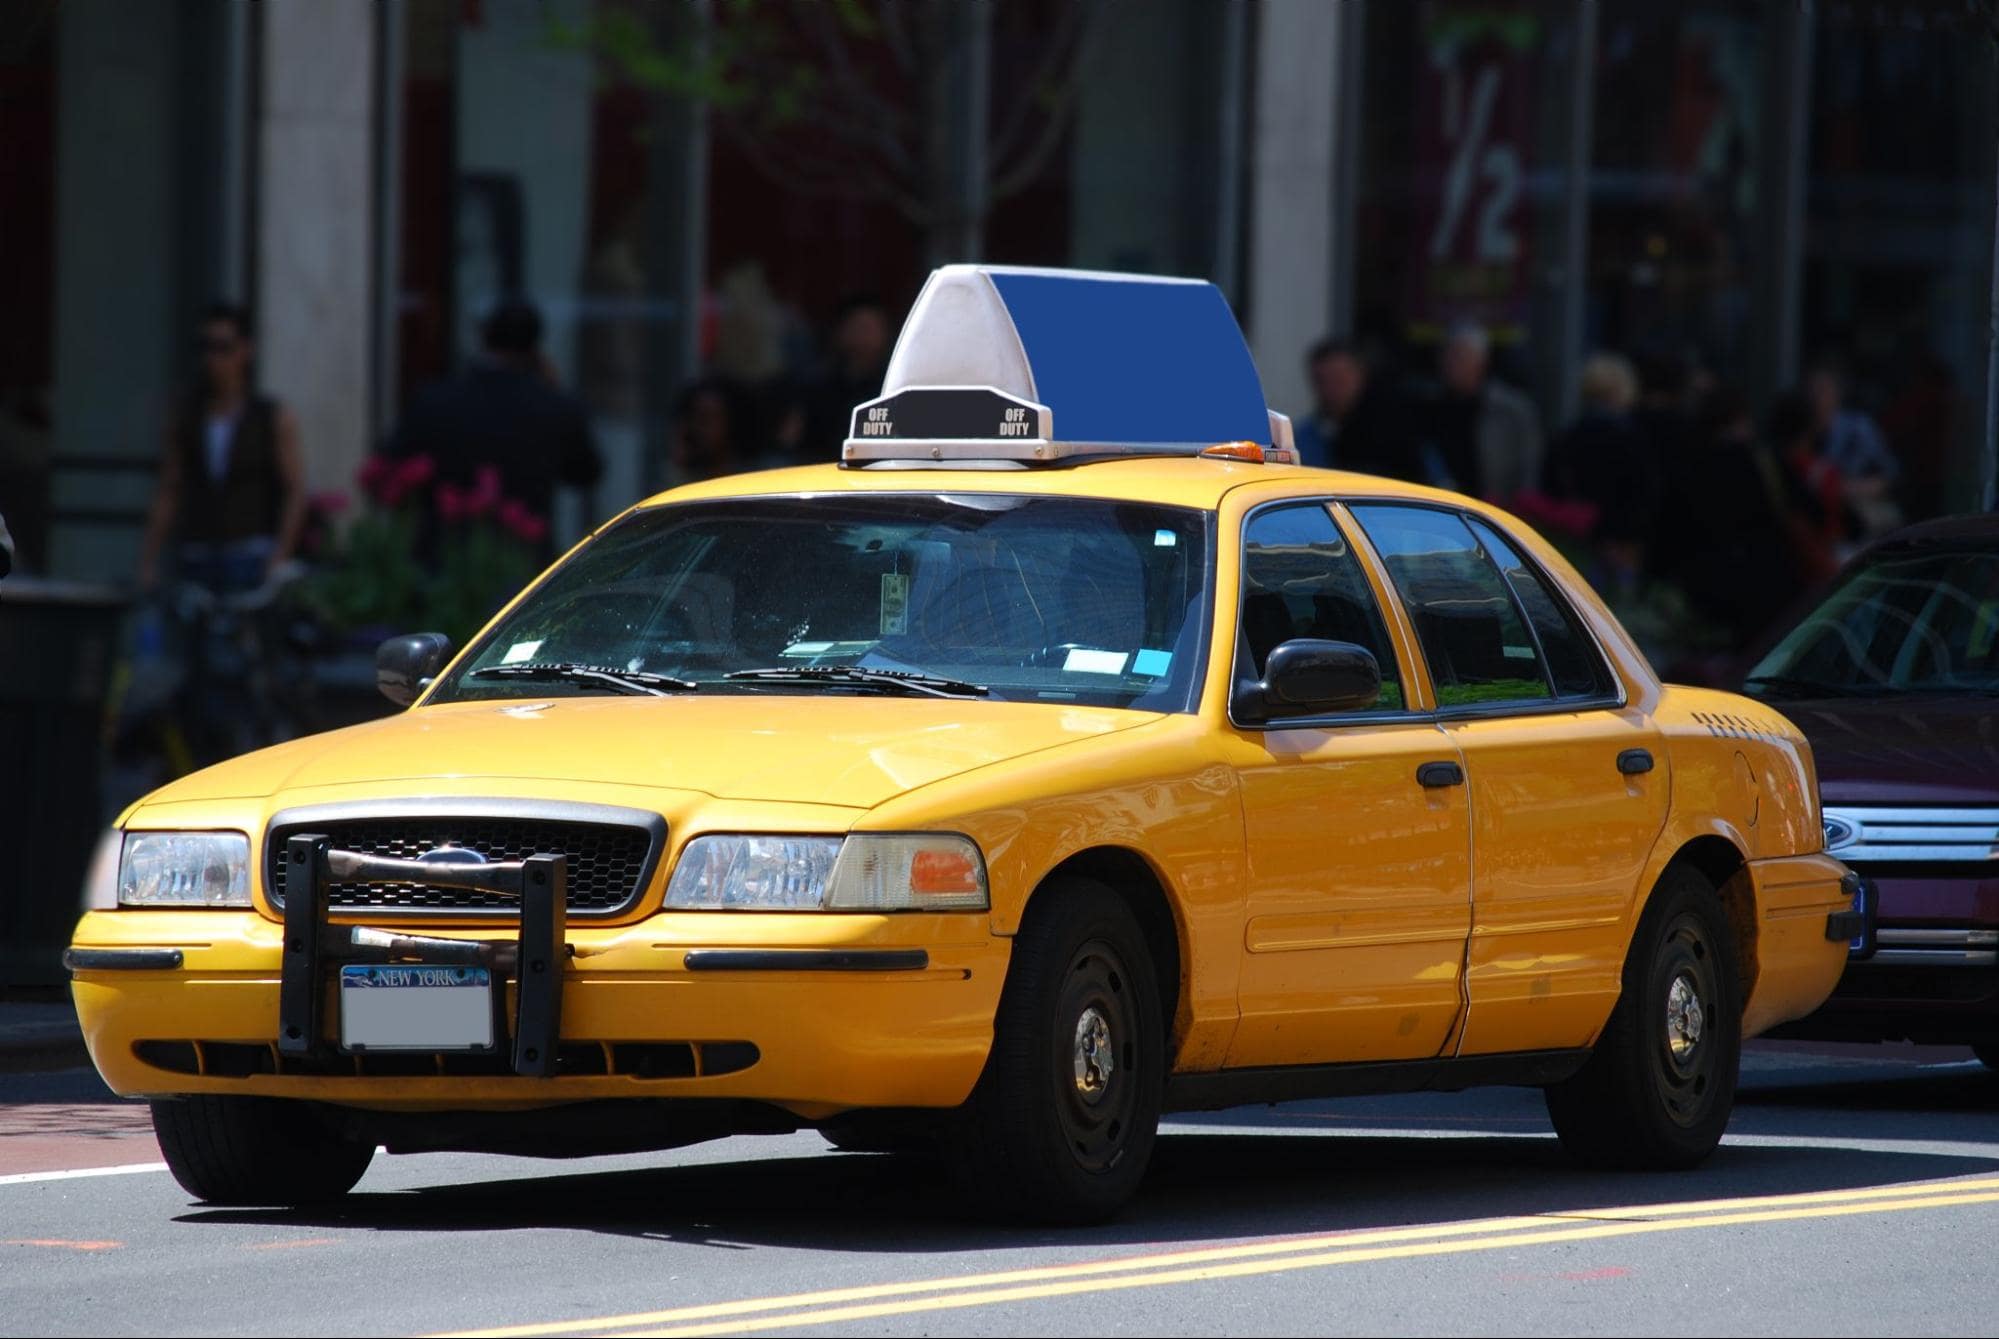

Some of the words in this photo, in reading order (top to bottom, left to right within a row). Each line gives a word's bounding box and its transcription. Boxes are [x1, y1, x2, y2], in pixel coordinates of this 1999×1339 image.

[868, 408, 888, 421] OFF
[1005, 408, 1025, 421] OFF
[863, 422, 892, 435] DUTY
[999, 422, 1029, 435] DUTY
[379, 970, 412, 986] NEW
[416, 970, 456, 986] YORK
